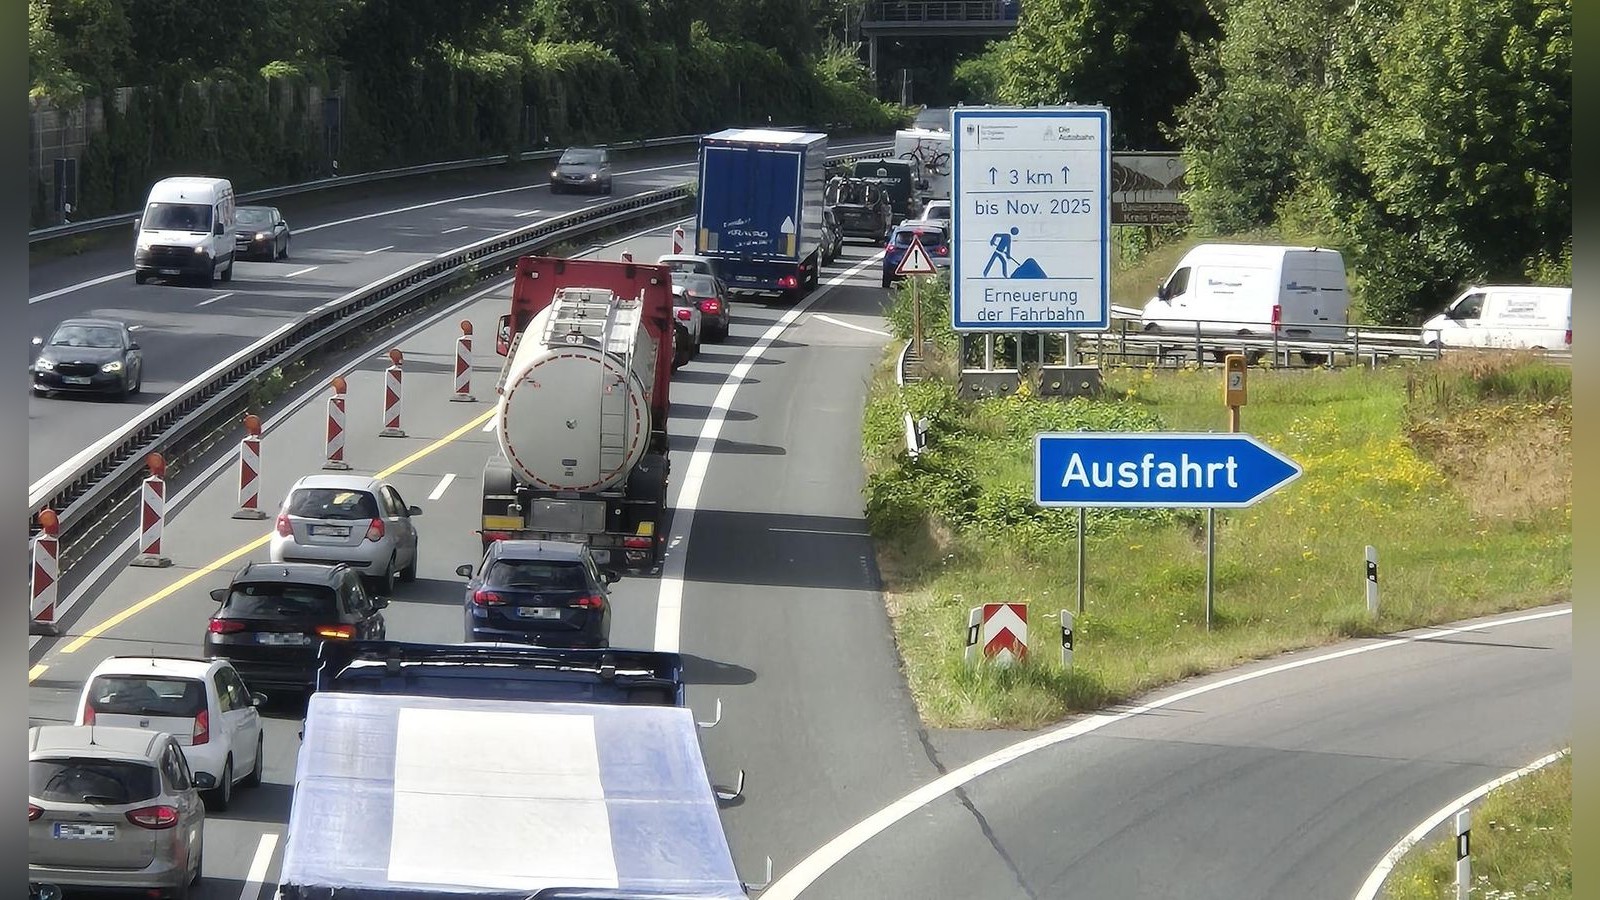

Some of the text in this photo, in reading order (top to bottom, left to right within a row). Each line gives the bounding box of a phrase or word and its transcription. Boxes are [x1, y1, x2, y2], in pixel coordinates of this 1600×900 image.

[1009, 169, 1053, 185] 3 km
[975, 198, 1091, 215] bis Nov. 2025
[984, 288, 1078, 305] Erneuerung
[977, 307, 1085, 321] der Fahrbahn
[1061, 452, 1238, 488] Ausfahrt
